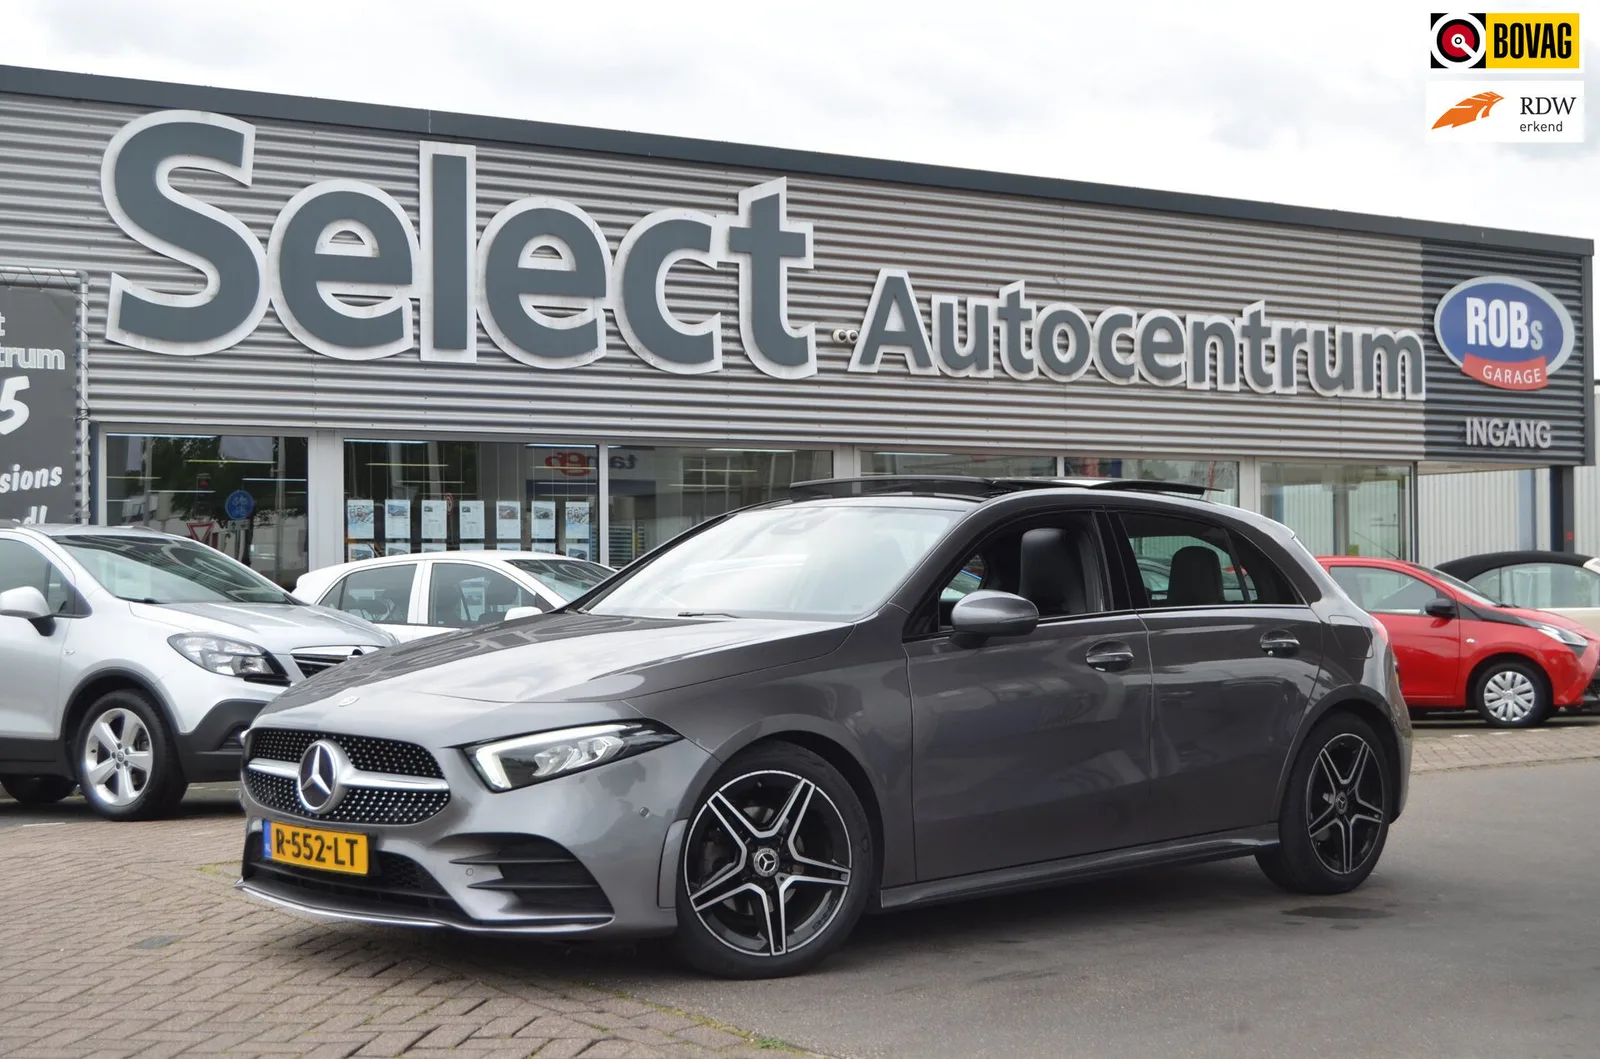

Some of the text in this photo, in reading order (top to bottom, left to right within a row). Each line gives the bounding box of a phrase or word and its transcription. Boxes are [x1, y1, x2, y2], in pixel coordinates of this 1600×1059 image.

[101, 110, 1426, 400] Select Autocentrum
[1466, 297, 1543, 350] ROBs
[1482, 364, 1542, 385] GARAGE
[1465, 416, 1552, 449] INGANG
[275, 828, 358, 866] R-552-LT
